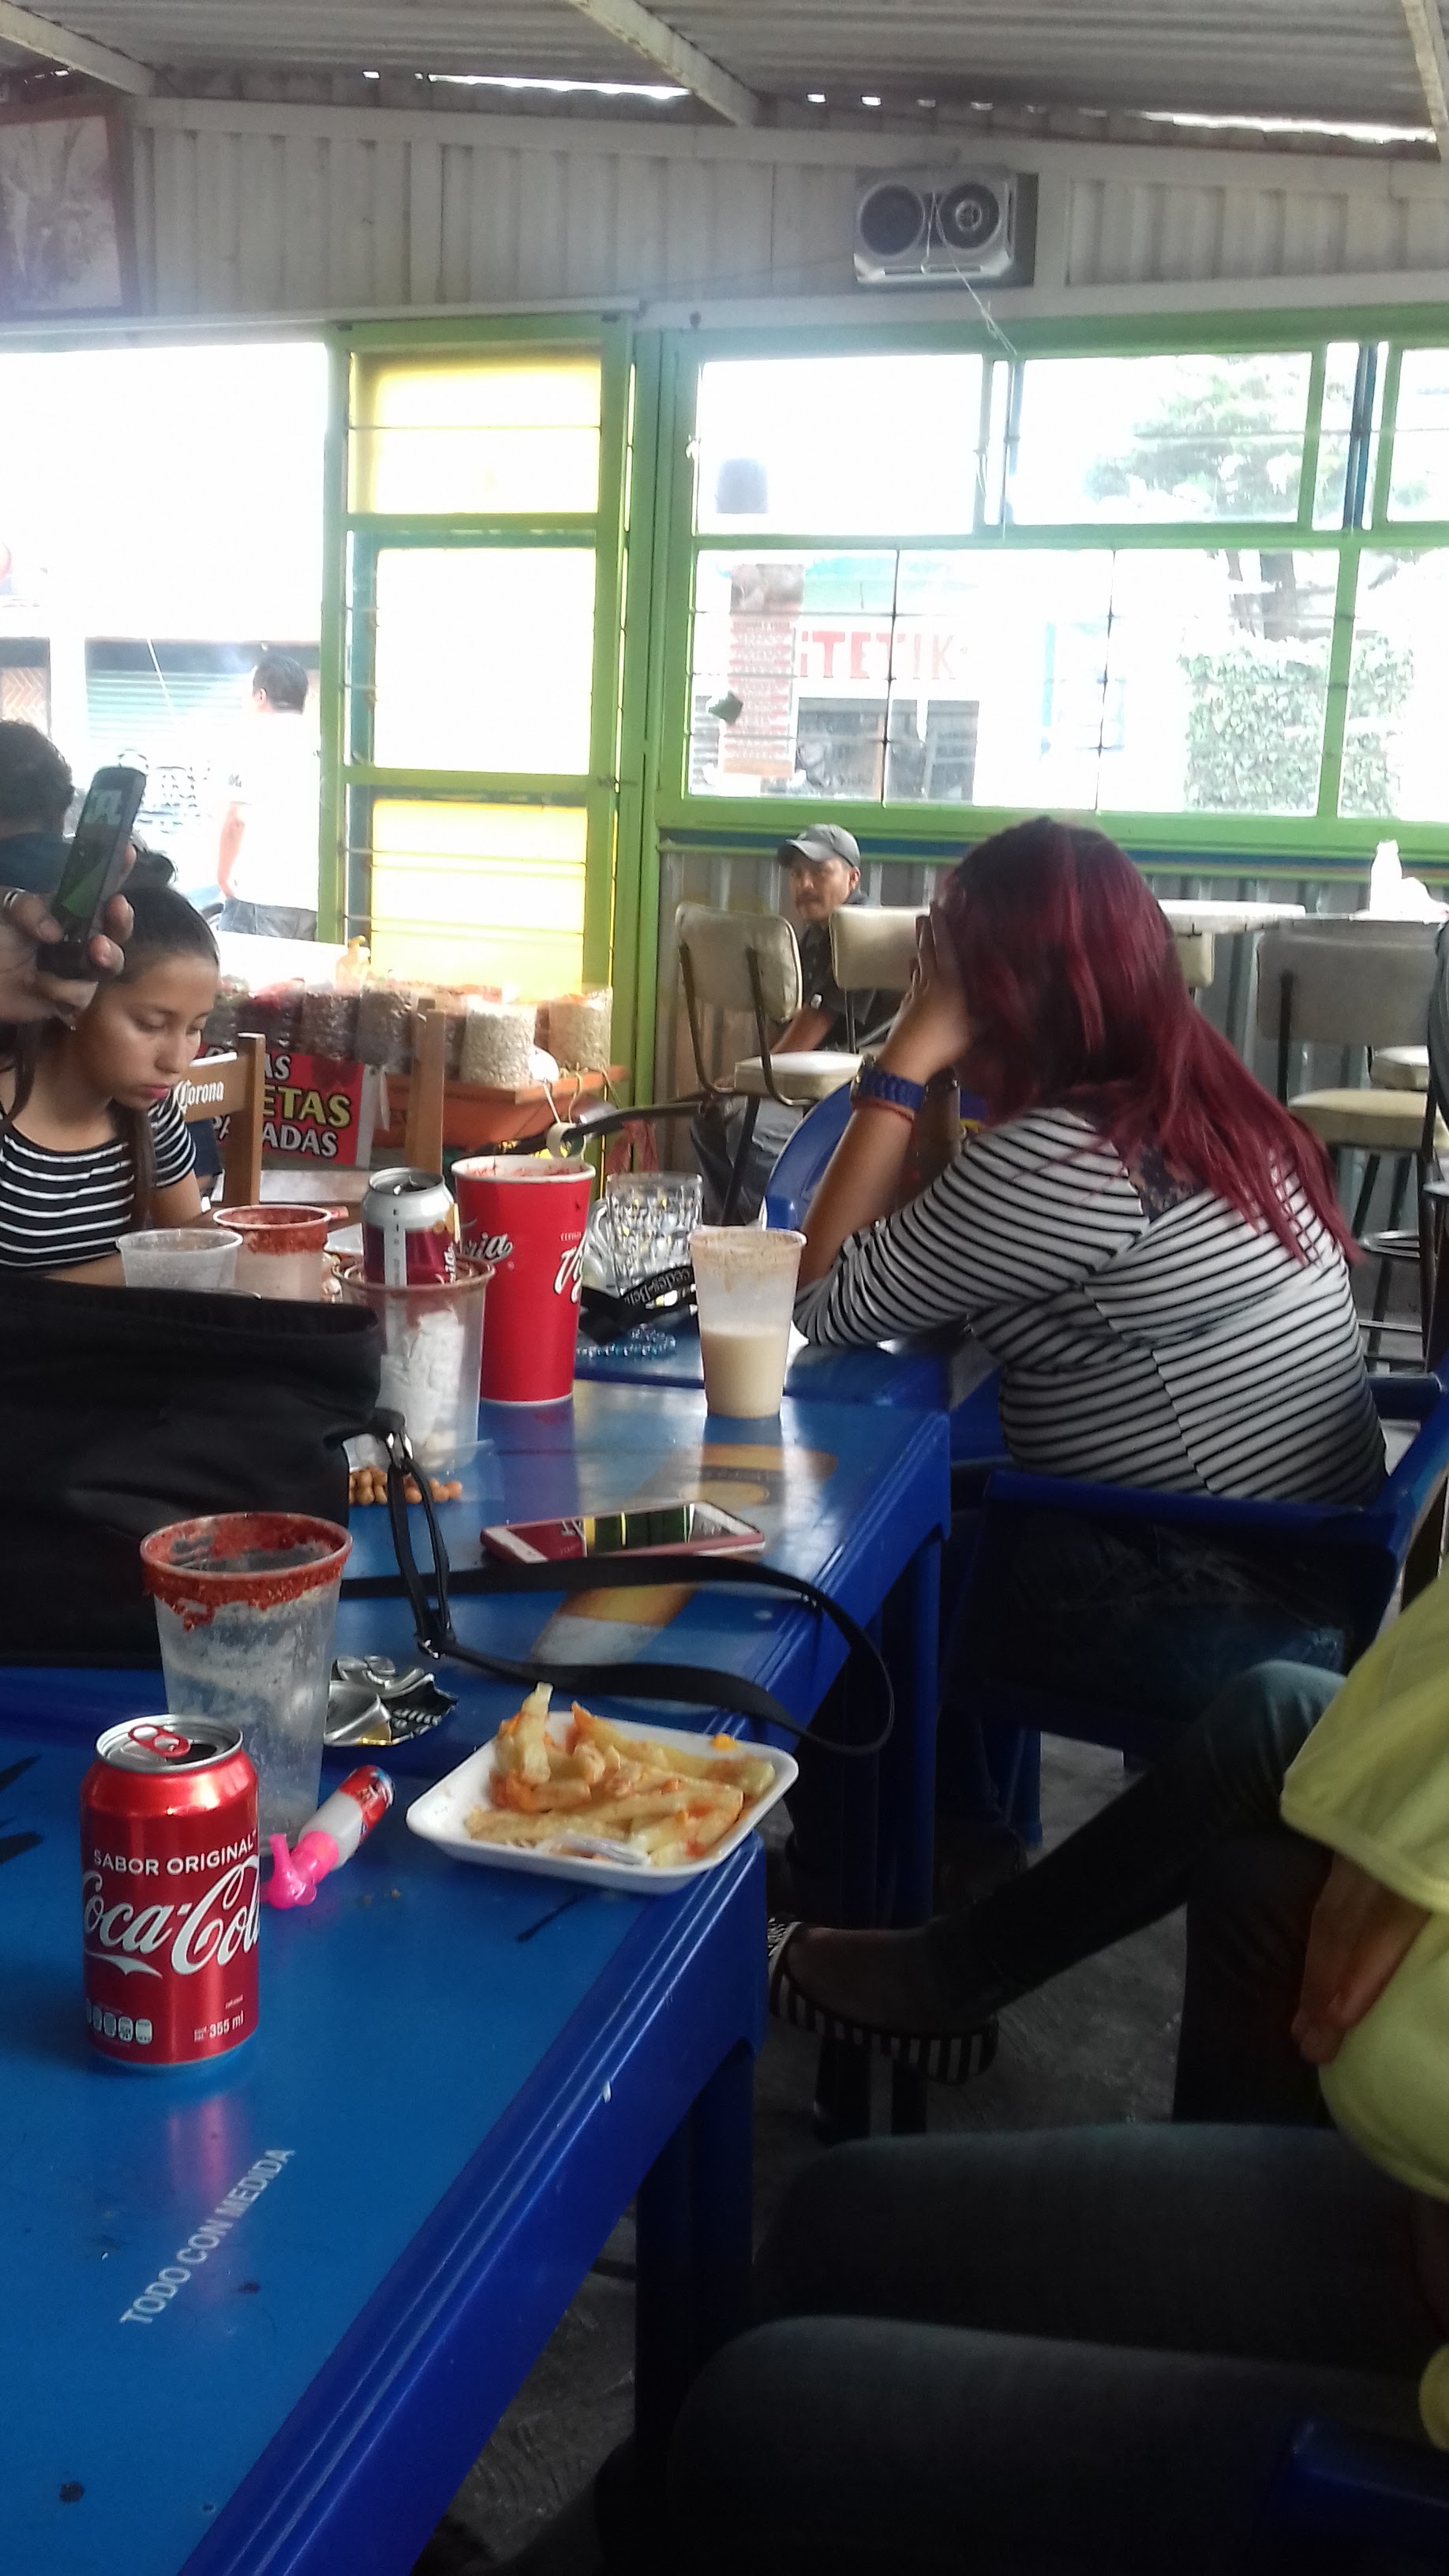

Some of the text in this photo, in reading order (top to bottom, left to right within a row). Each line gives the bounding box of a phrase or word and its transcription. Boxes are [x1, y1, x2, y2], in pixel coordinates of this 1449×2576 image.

[173, 1079, 224, 1115] Corona
[264, 1084, 351, 1129] ETAS
[263, 1121, 338, 1158] ADAS
[94, 1833, 254, 1876] SABOR ORIGINAL
[209, 2018, 230, 2039] 355
[232, 2009, 244, 2030] ml
[120, 2149, 296, 2324] TODO CON MEDIDA
